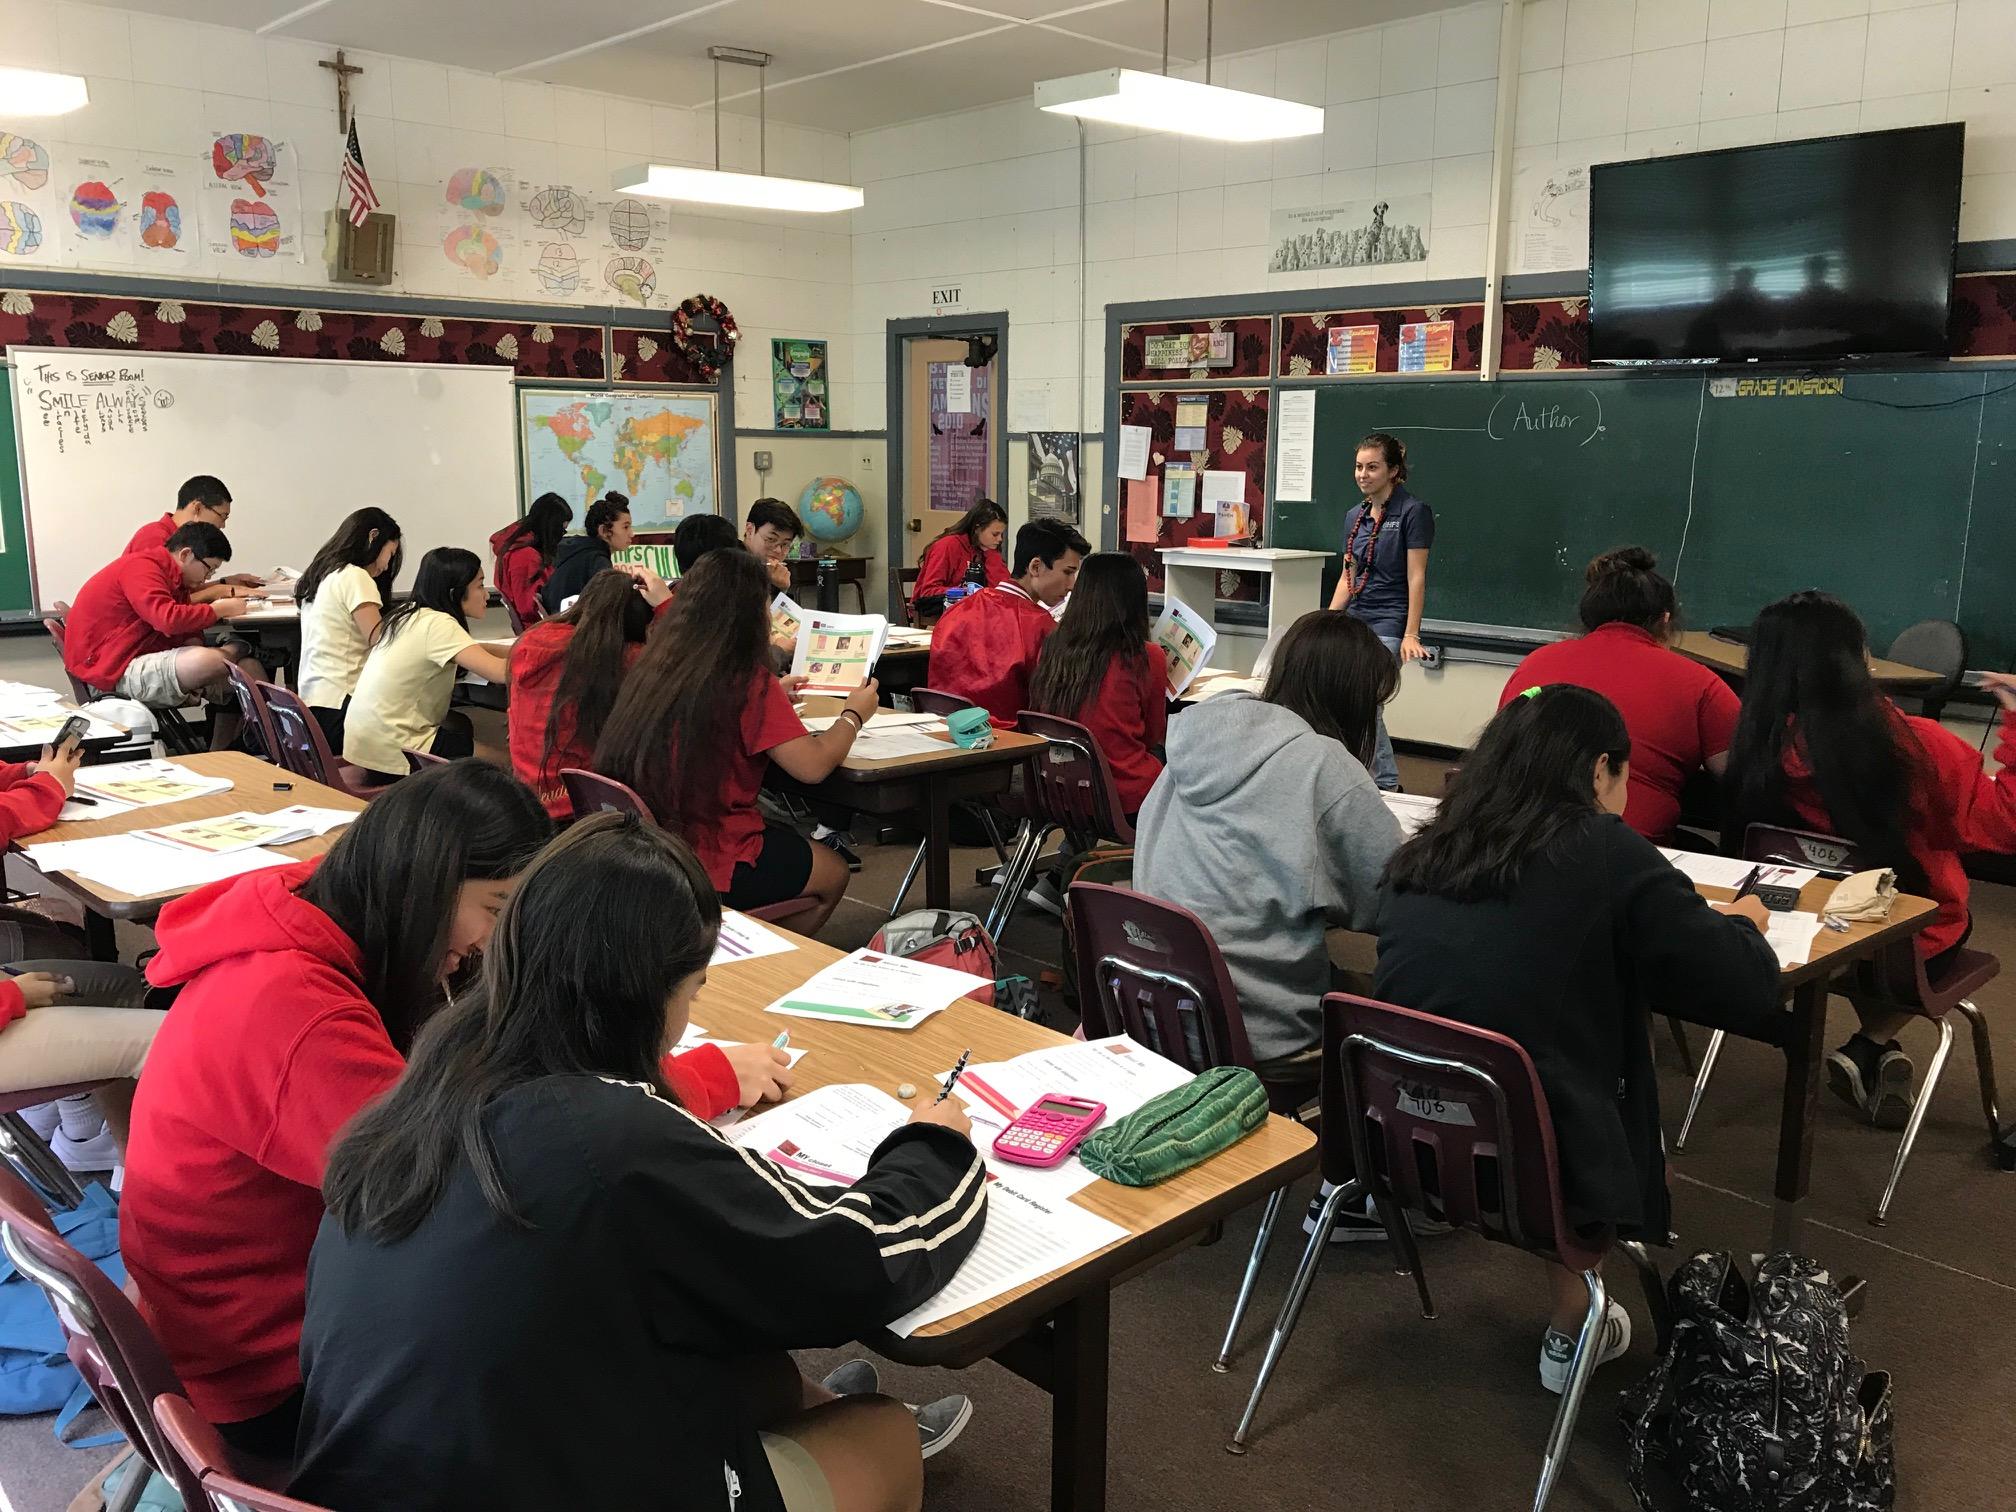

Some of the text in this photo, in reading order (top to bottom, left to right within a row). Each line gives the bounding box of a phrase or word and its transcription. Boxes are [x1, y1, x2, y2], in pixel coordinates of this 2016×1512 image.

[933, 289, 961, 304] EXIT
[81, 369, 115, 381] SENIOR
[1738, 379, 1777, 396] GRADE
[38, 389, 92, 411] SMILE
[1809, 844, 1839, 861] 406
[796, 1151, 810, 1160] MY
[1002, 1186, 1019, 1196] Debit
[1029, 1201, 1053, 1214] Register
